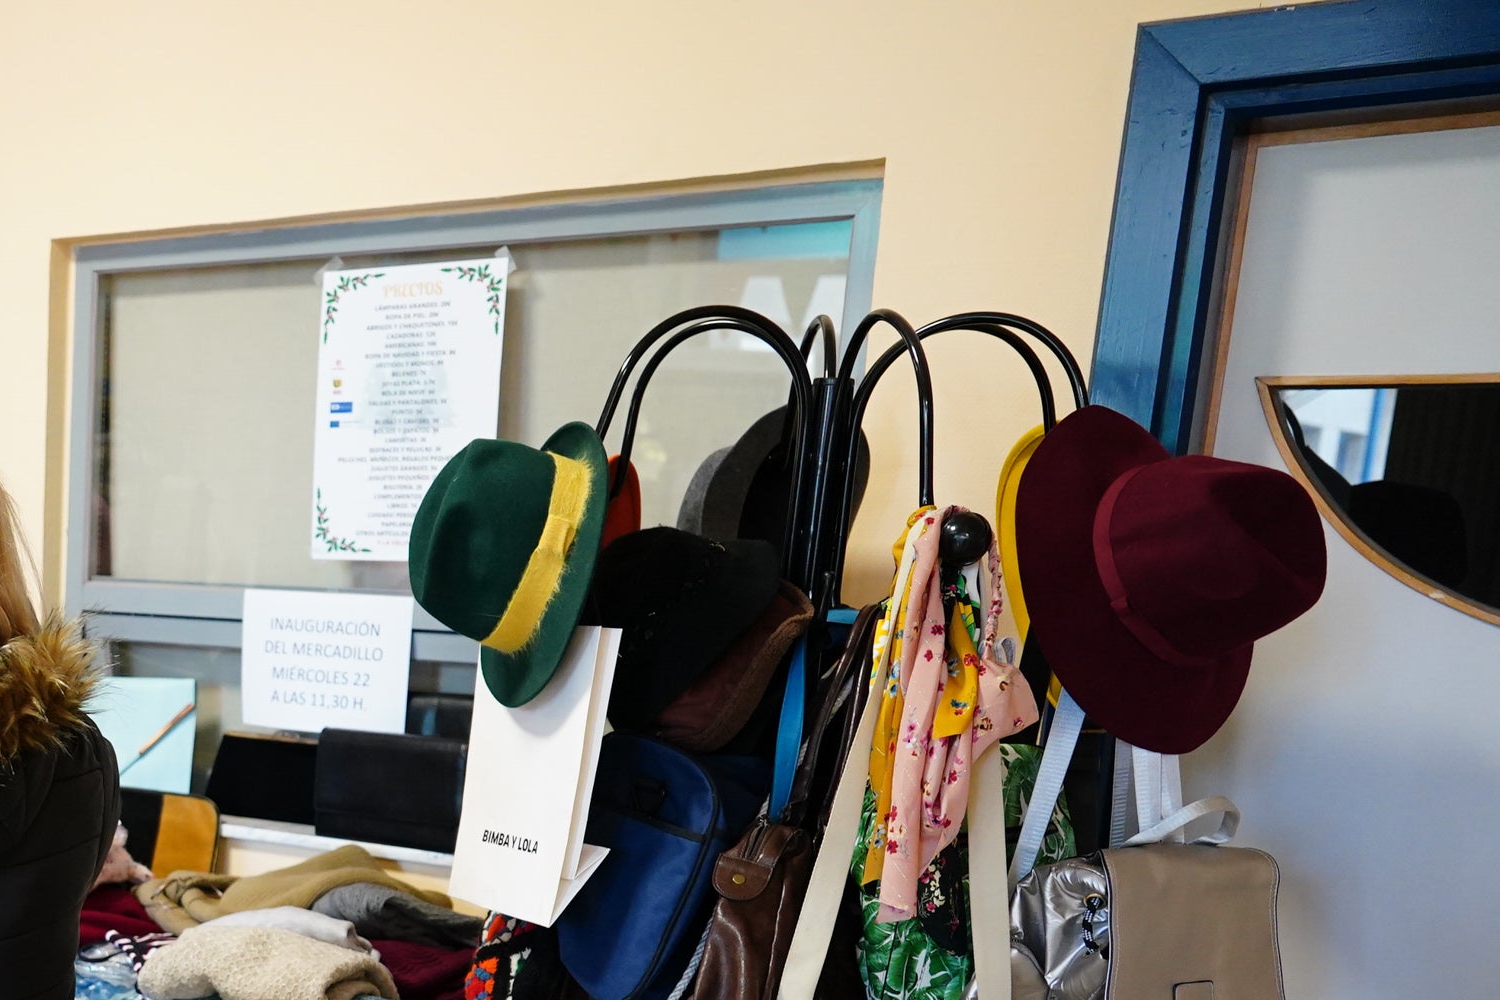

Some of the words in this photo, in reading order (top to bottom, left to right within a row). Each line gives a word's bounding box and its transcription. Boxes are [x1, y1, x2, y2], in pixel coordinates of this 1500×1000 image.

[270, 617, 380, 637] INAUGURACIÓN
[265, 639, 288, 655] DEL
[293, 641, 383, 661] MERCADILLO
[272, 663, 349, 685] MIÉRCOLES
[352, 673, 370, 686] 22
[271, 689, 280, 702] A
[283, 690, 306, 705] LAS
[482, 829, 510, 847] BIMBA
[518, 837, 538, 854] LOLA
